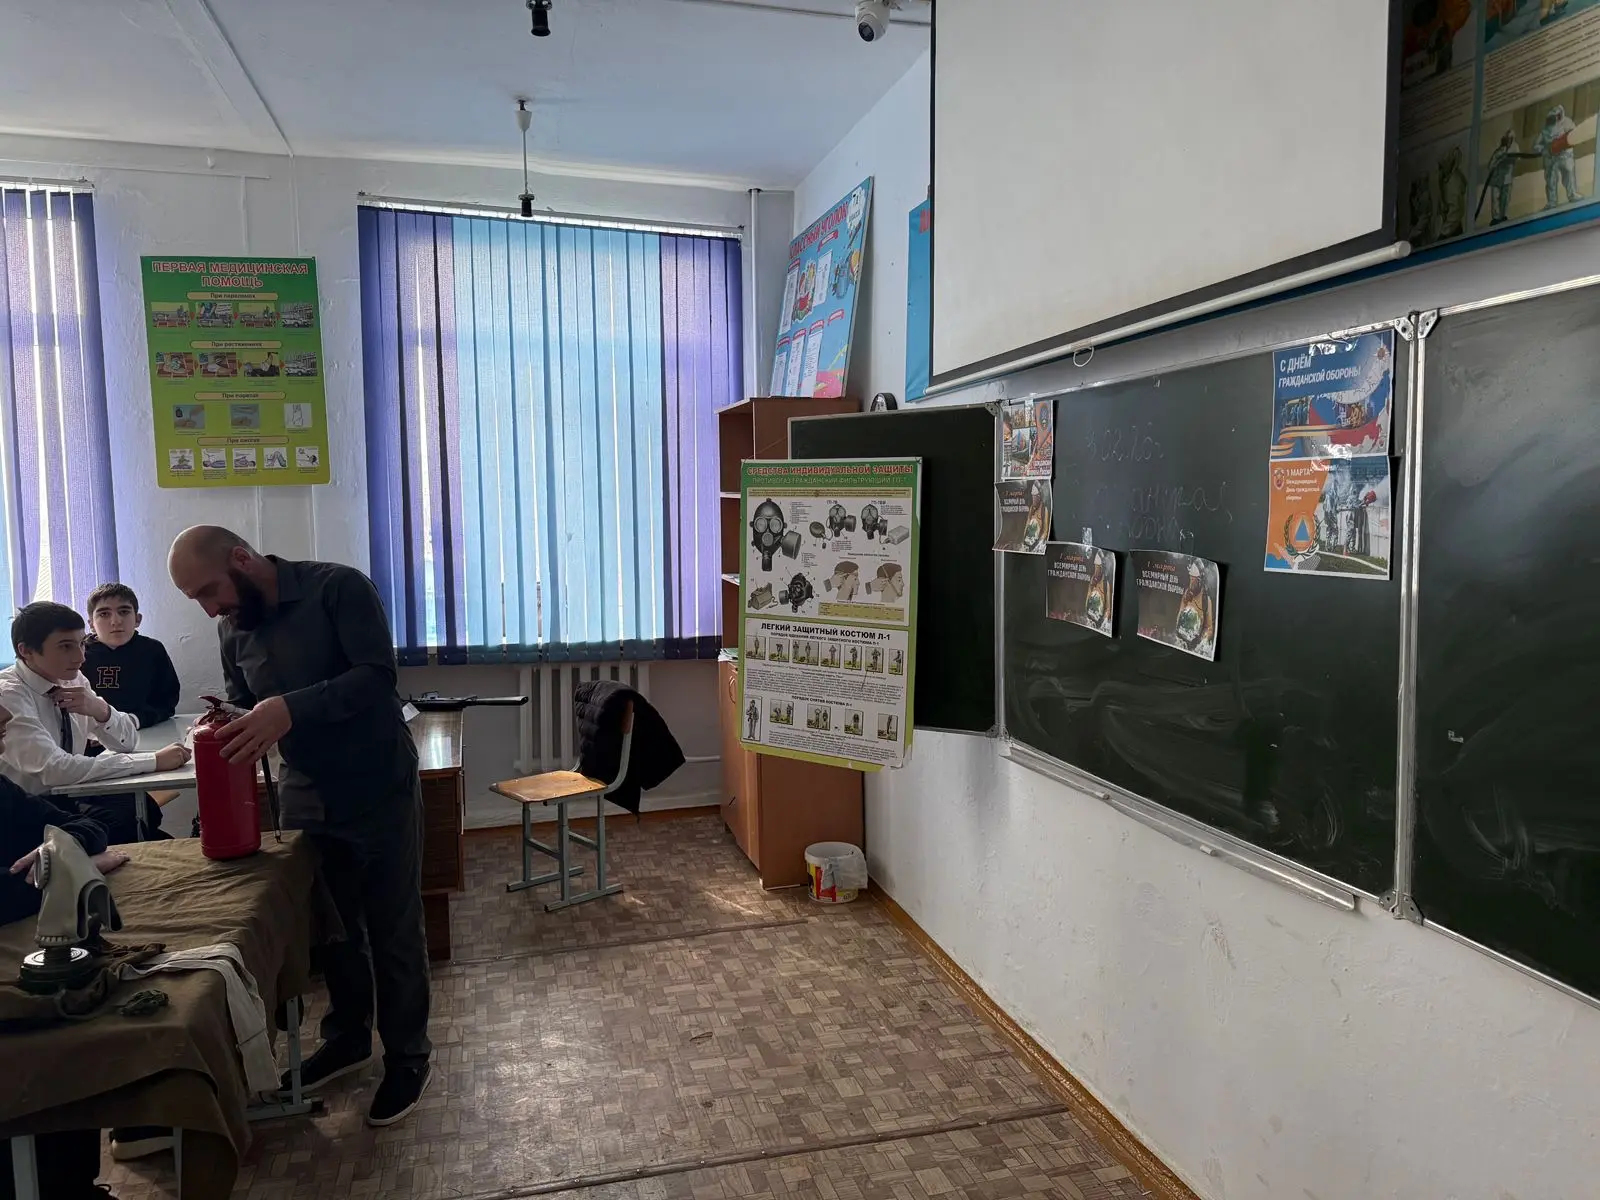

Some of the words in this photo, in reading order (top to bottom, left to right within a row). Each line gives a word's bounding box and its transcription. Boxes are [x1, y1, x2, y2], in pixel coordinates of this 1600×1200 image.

[152, 262, 206, 273] ПЕРВАЯ
[208, 262, 309, 275] МЕДИЦИНСКАЯ
[201, 275, 264, 289] ПОМОЩЬ
[210, 292, 222, 300] При
[1280, 359, 1287, 373] С
[1287, 354, 1312, 374] ДНЁМ
[1278, 369, 1325, 389] ГРАЖДАНСКОЙ
[1325, 366, 1361, 381] ОБОРОНЫ
[747, 466, 789, 476] СРЕДСТВА
[790, 464, 871, 475] ИНДИВИДУАЛЬНОЙ
[873, 464, 913, 475] ЗАЩИТЫ
[1290, 468, 1311, 476] МАРТА
[761, 622, 791, 632] ЛЕГКИЙ
[792, 624, 839, 637] ЗАЩИТНЫЙ
[840, 630, 876, 640] КОСТЮМ
[877, 632, 891, 641] Л-1
[96, 666, 121, 689] H
